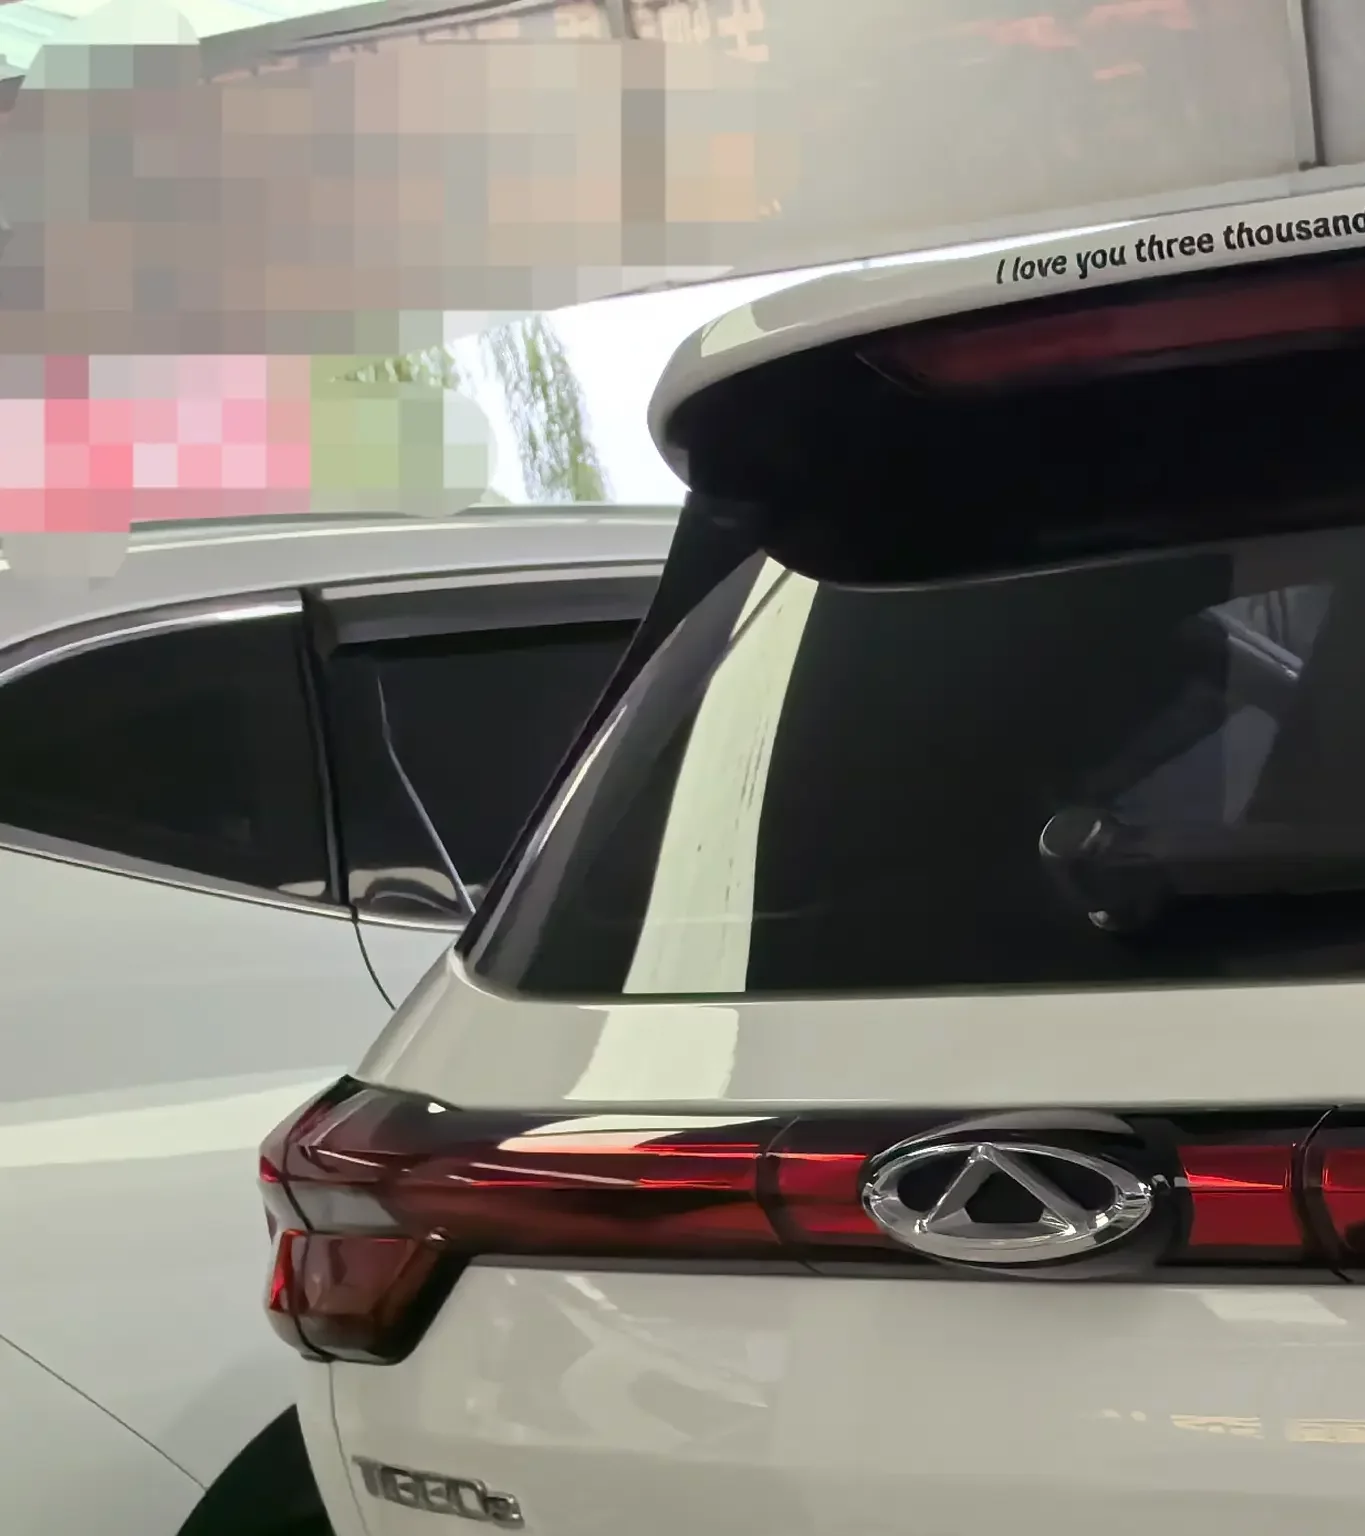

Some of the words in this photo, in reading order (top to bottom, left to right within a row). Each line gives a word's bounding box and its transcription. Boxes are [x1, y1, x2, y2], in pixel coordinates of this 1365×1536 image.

[995, 259, 1006, 284] I
[1012, 253, 1067, 282] love
[1076, 245, 1127, 279] you
[1135, 232, 1215, 263] three
